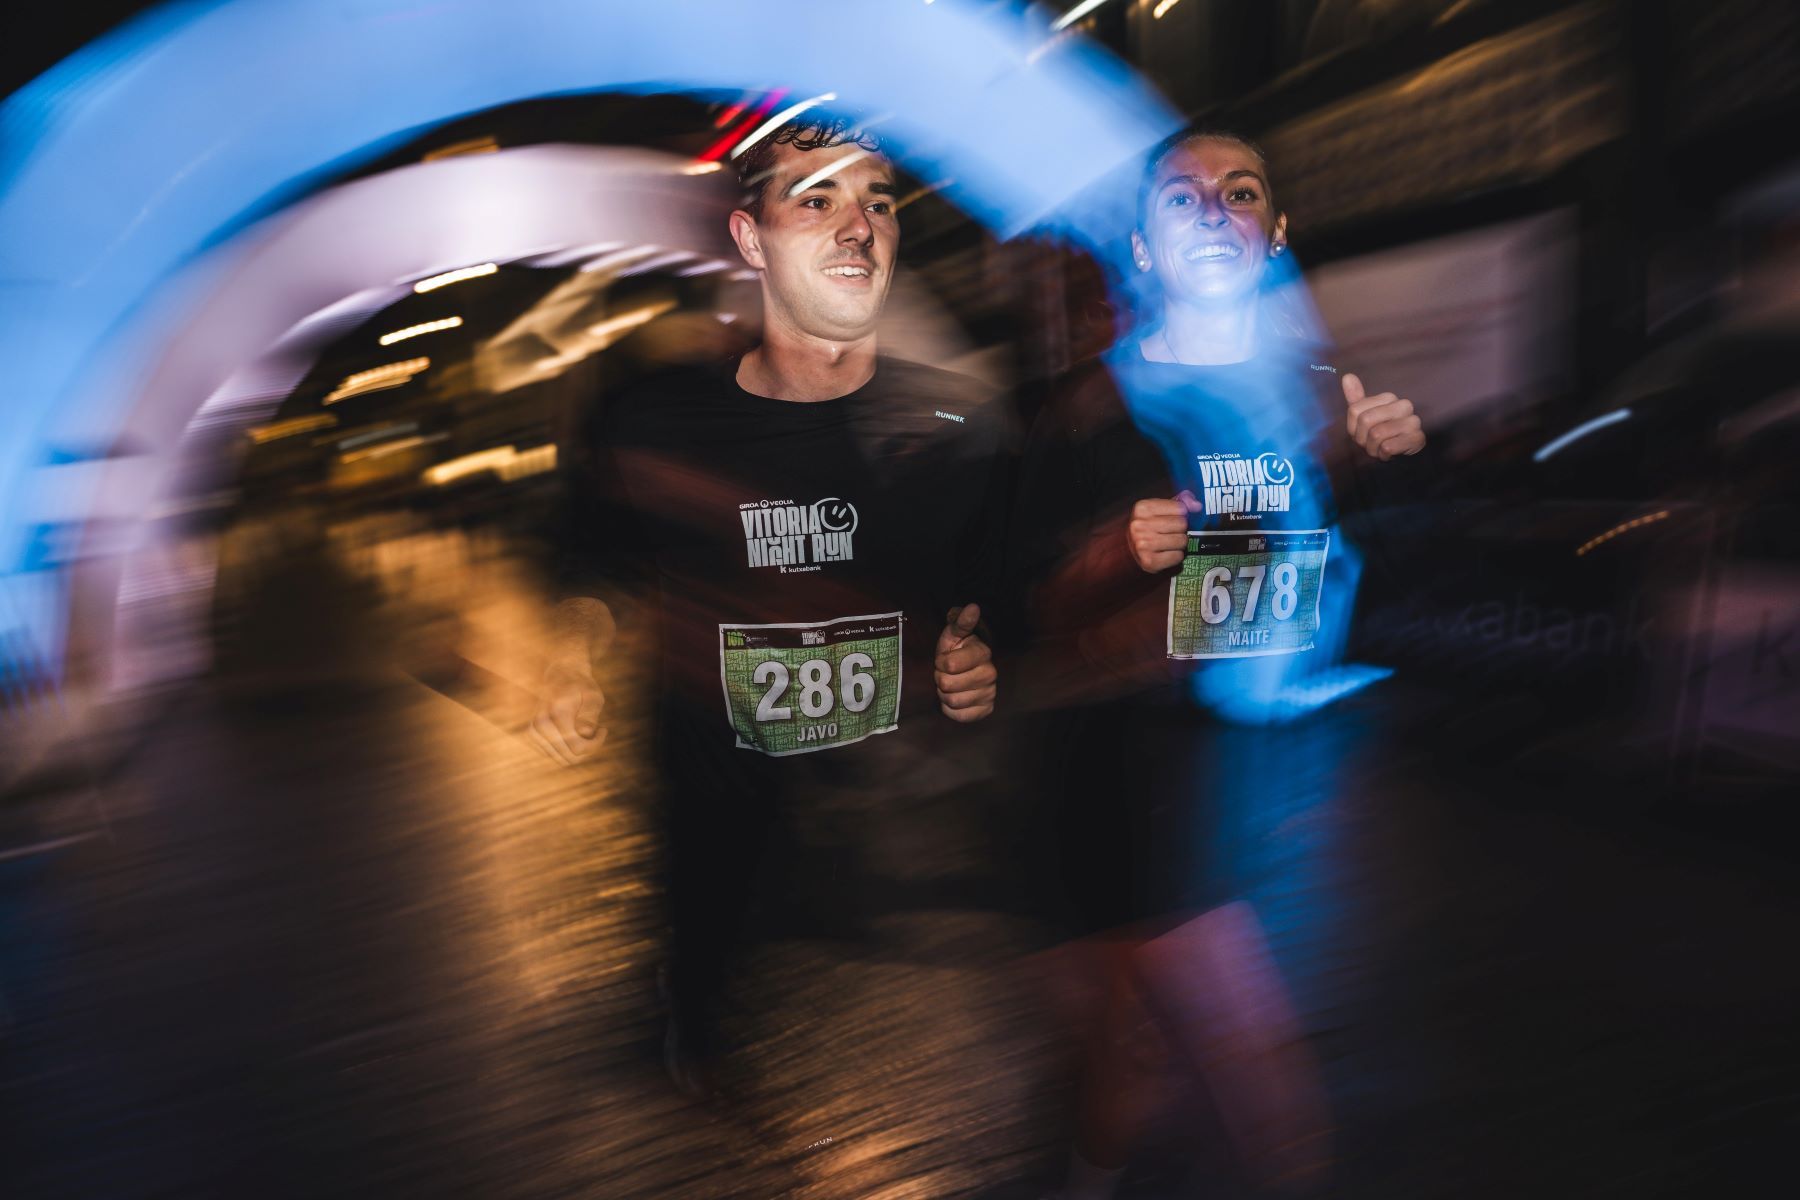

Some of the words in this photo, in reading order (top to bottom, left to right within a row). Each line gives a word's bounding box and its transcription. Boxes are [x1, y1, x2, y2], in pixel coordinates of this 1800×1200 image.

[935, 410, 965, 423] RUNNEK
[1199, 459, 1266, 488] VITORIA
[769, 499, 795, 507] VEOLIA
[1204, 484, 1254, 515] NIGHT
[1256, 484, 1290, 512] RUN
[740, 505, 823, 539] VITORIA
[746, 534, 806, 568] NIGHT
[811, 531, 854, 563] RUN
[788, 565, 822, 573] kutxabank
[1200, 562, 1298, 625] 678
[1228, 630, 1270, 647] MAITE
[753, 653, 876, 722] 286
[796, 722, 839, 742] JAVO
